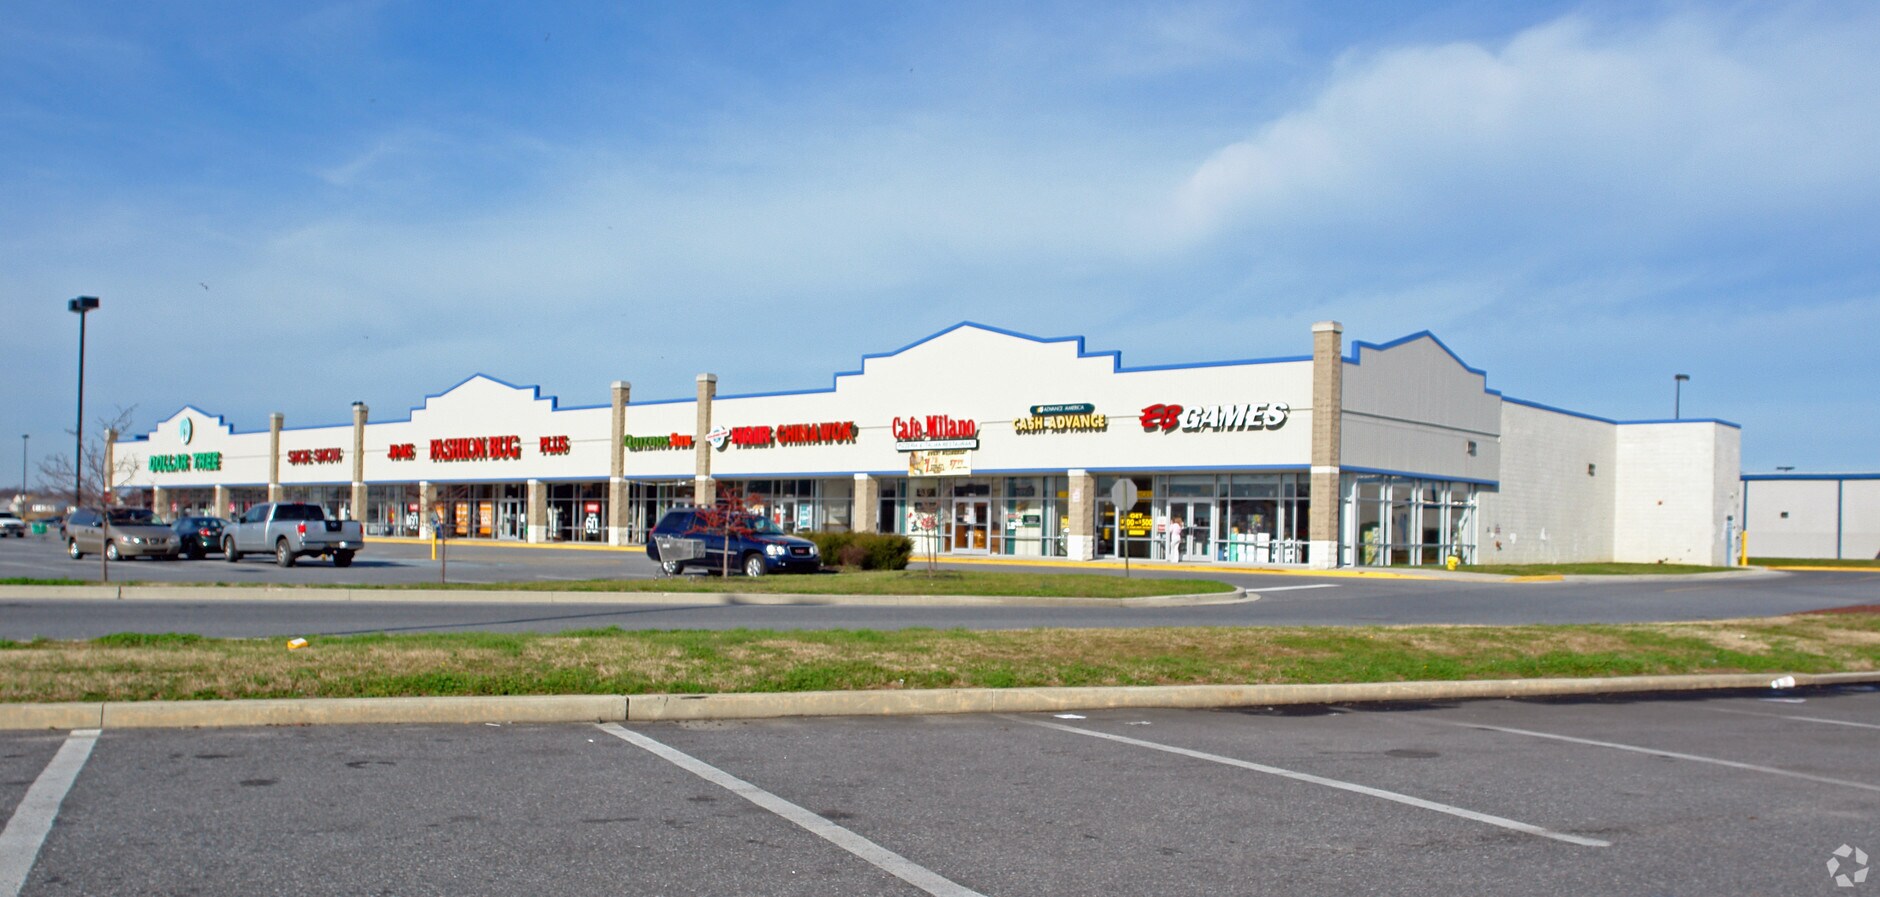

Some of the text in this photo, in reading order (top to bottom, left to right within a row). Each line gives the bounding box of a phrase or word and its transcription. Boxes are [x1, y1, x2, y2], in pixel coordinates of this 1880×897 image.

[1044, 405, 1063, 413] ADVANCE
[1139, 402, 1289, 431] EB GAMES
[776, 421, 855, 443] CHINA WOK
[926, 414, 976, 438] Milano
[1012, 414, 1106, 431] CASH ADVANCE
[539, 436, 569, 453] PLUS
[731, 425, 772, 445] HAIR
[287, 448, 342, 463] SHOE SHOW
[430, 435, 520, 461] FASHION BUG
[148, 451, 220, 471] DOLLAR TREE
